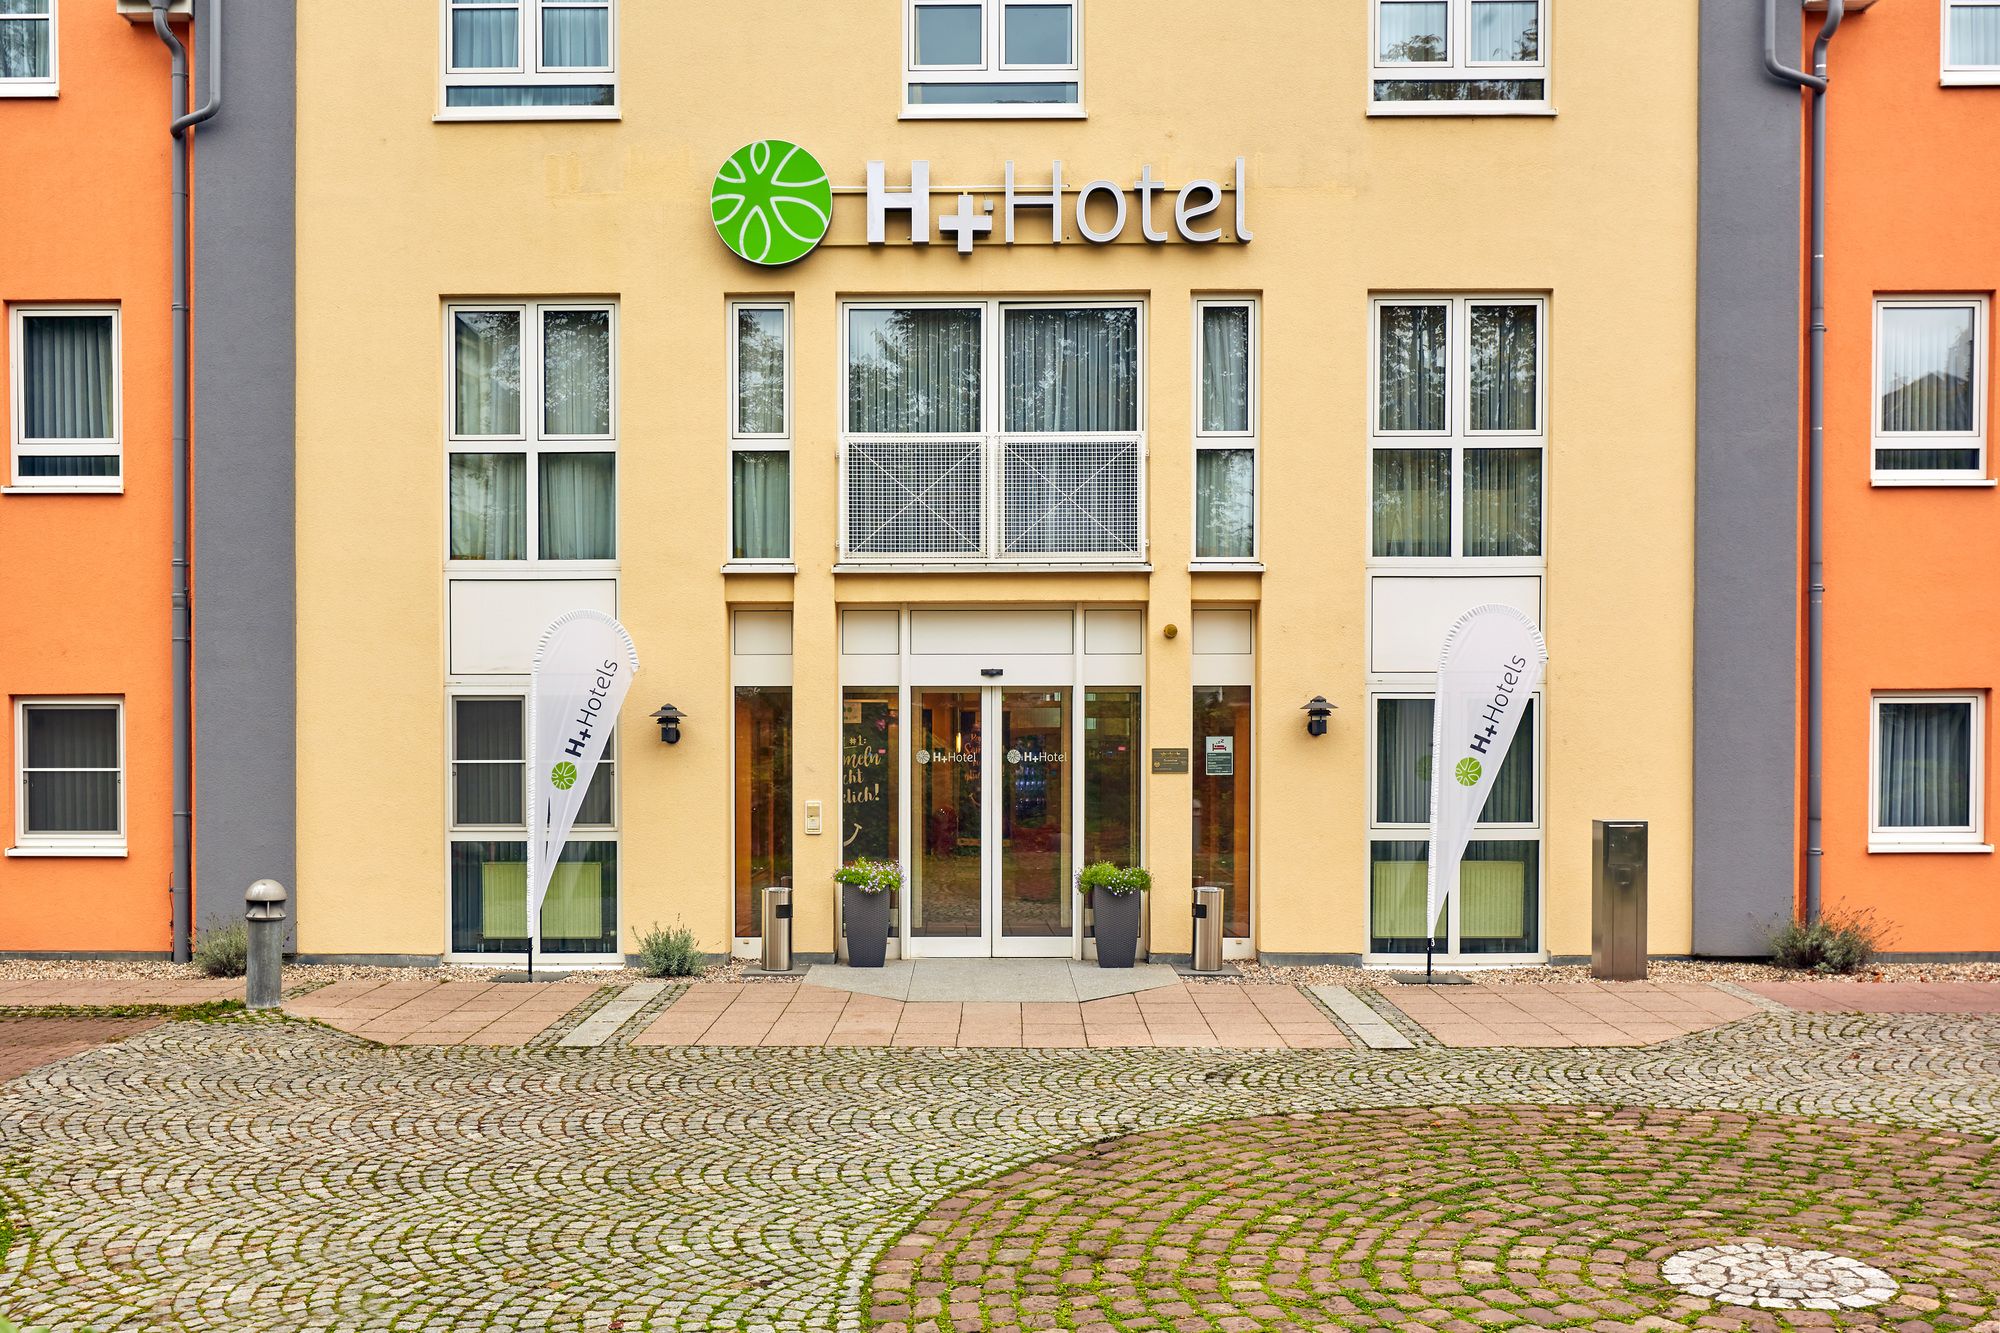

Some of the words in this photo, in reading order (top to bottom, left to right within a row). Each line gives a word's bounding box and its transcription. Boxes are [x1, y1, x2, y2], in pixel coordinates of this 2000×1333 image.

[866, 156, 1254, 256] H+Hotel
[564, 659, 619, 757] H+Hotels
[1469, 655, 1526, 754] H+Hotels
[932, 752, 977, 764] H+Hotel
[1024, 751, 1068, 763] H+Hotel
